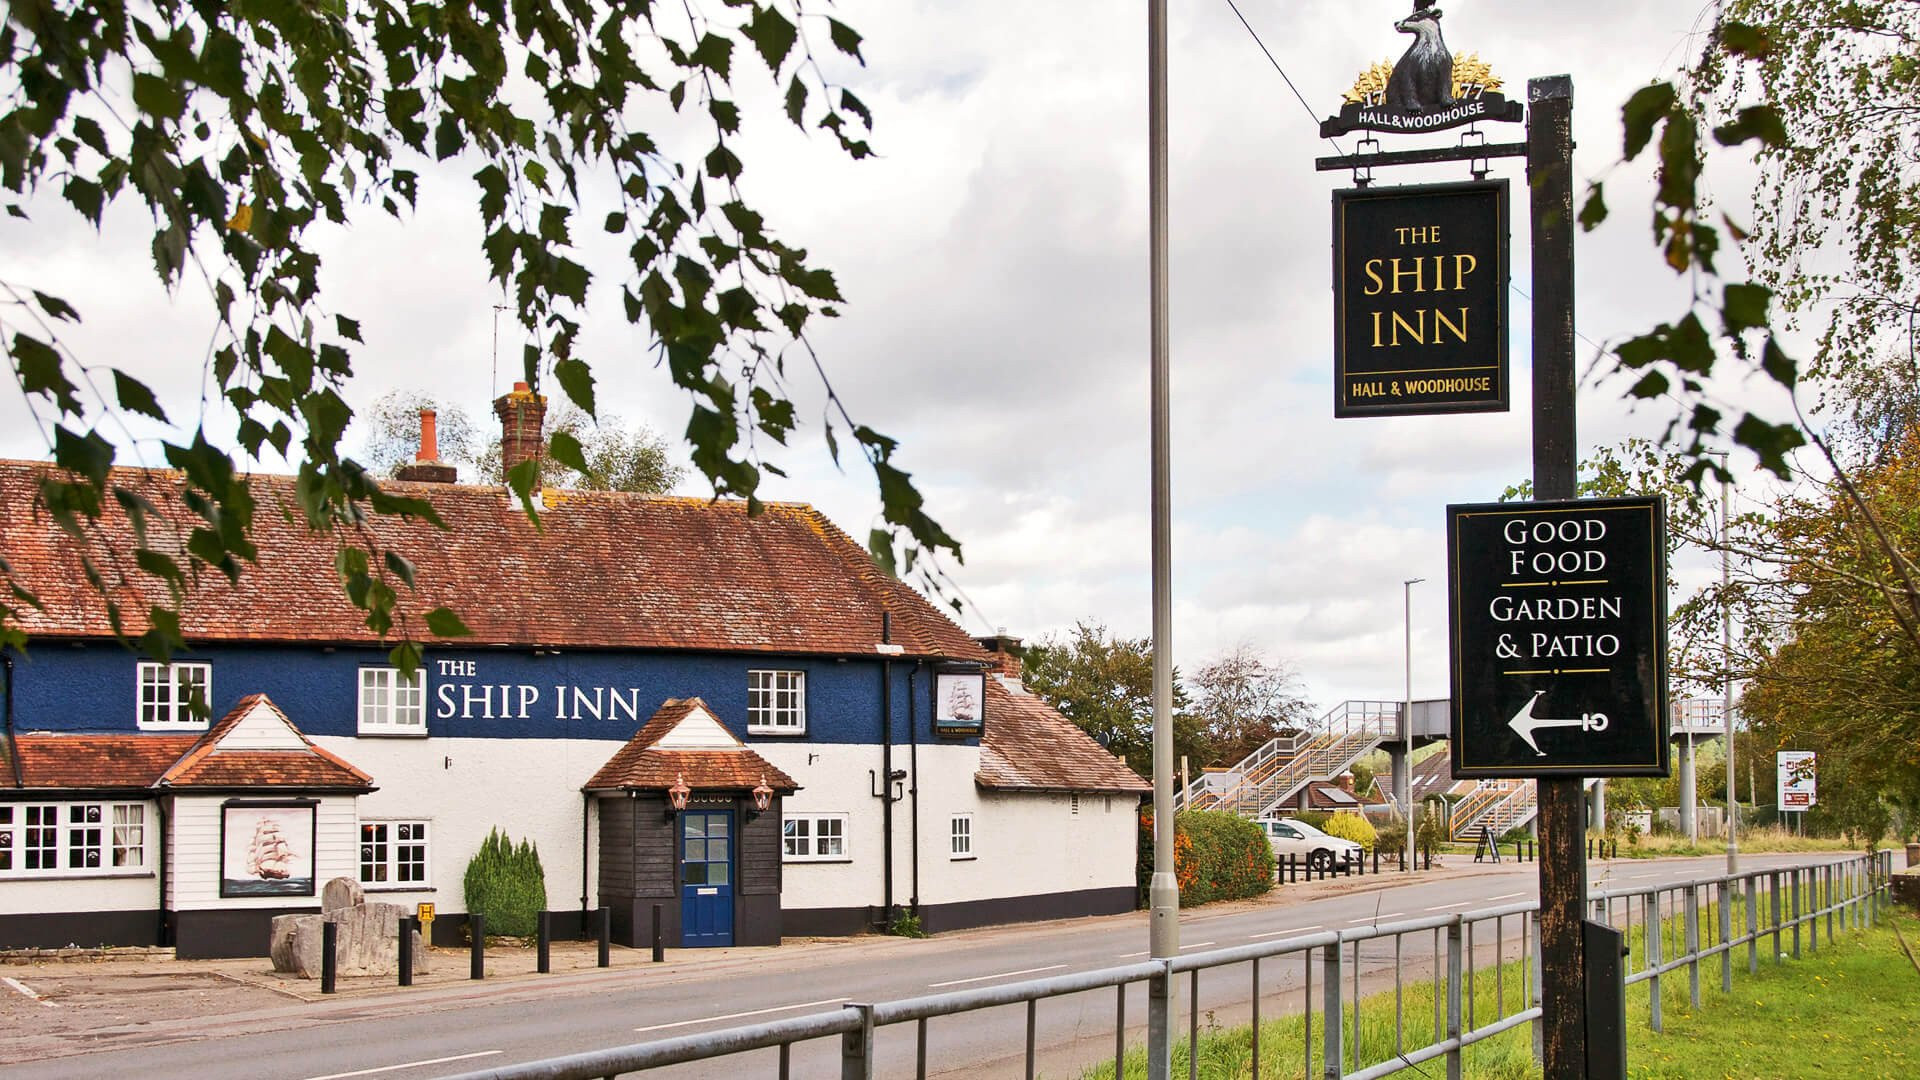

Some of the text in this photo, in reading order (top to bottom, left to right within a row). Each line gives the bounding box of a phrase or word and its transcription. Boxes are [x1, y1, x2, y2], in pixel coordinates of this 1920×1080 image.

[1363, 83, 1485, 109] 17 77
[1395, 226, 1441, 245] THE
[1364, 254, 1477, 295] SHIP
[1371, 307, 1470, 348] INN
[1353, 377, 1490, 398] HALL & WOODHOUSE
[1504, 519, 1607, 545] GOOD
[1510, 550, 1607, 575] FOOD
[1490, 596, 1622, 621] GARDEN
[1495, 632, 1620, 659] & PATIO
[437, 660, 476, 676] THE
[437, 683, 640, 721] SHIP INN
[422, 906, 432, 917] H
